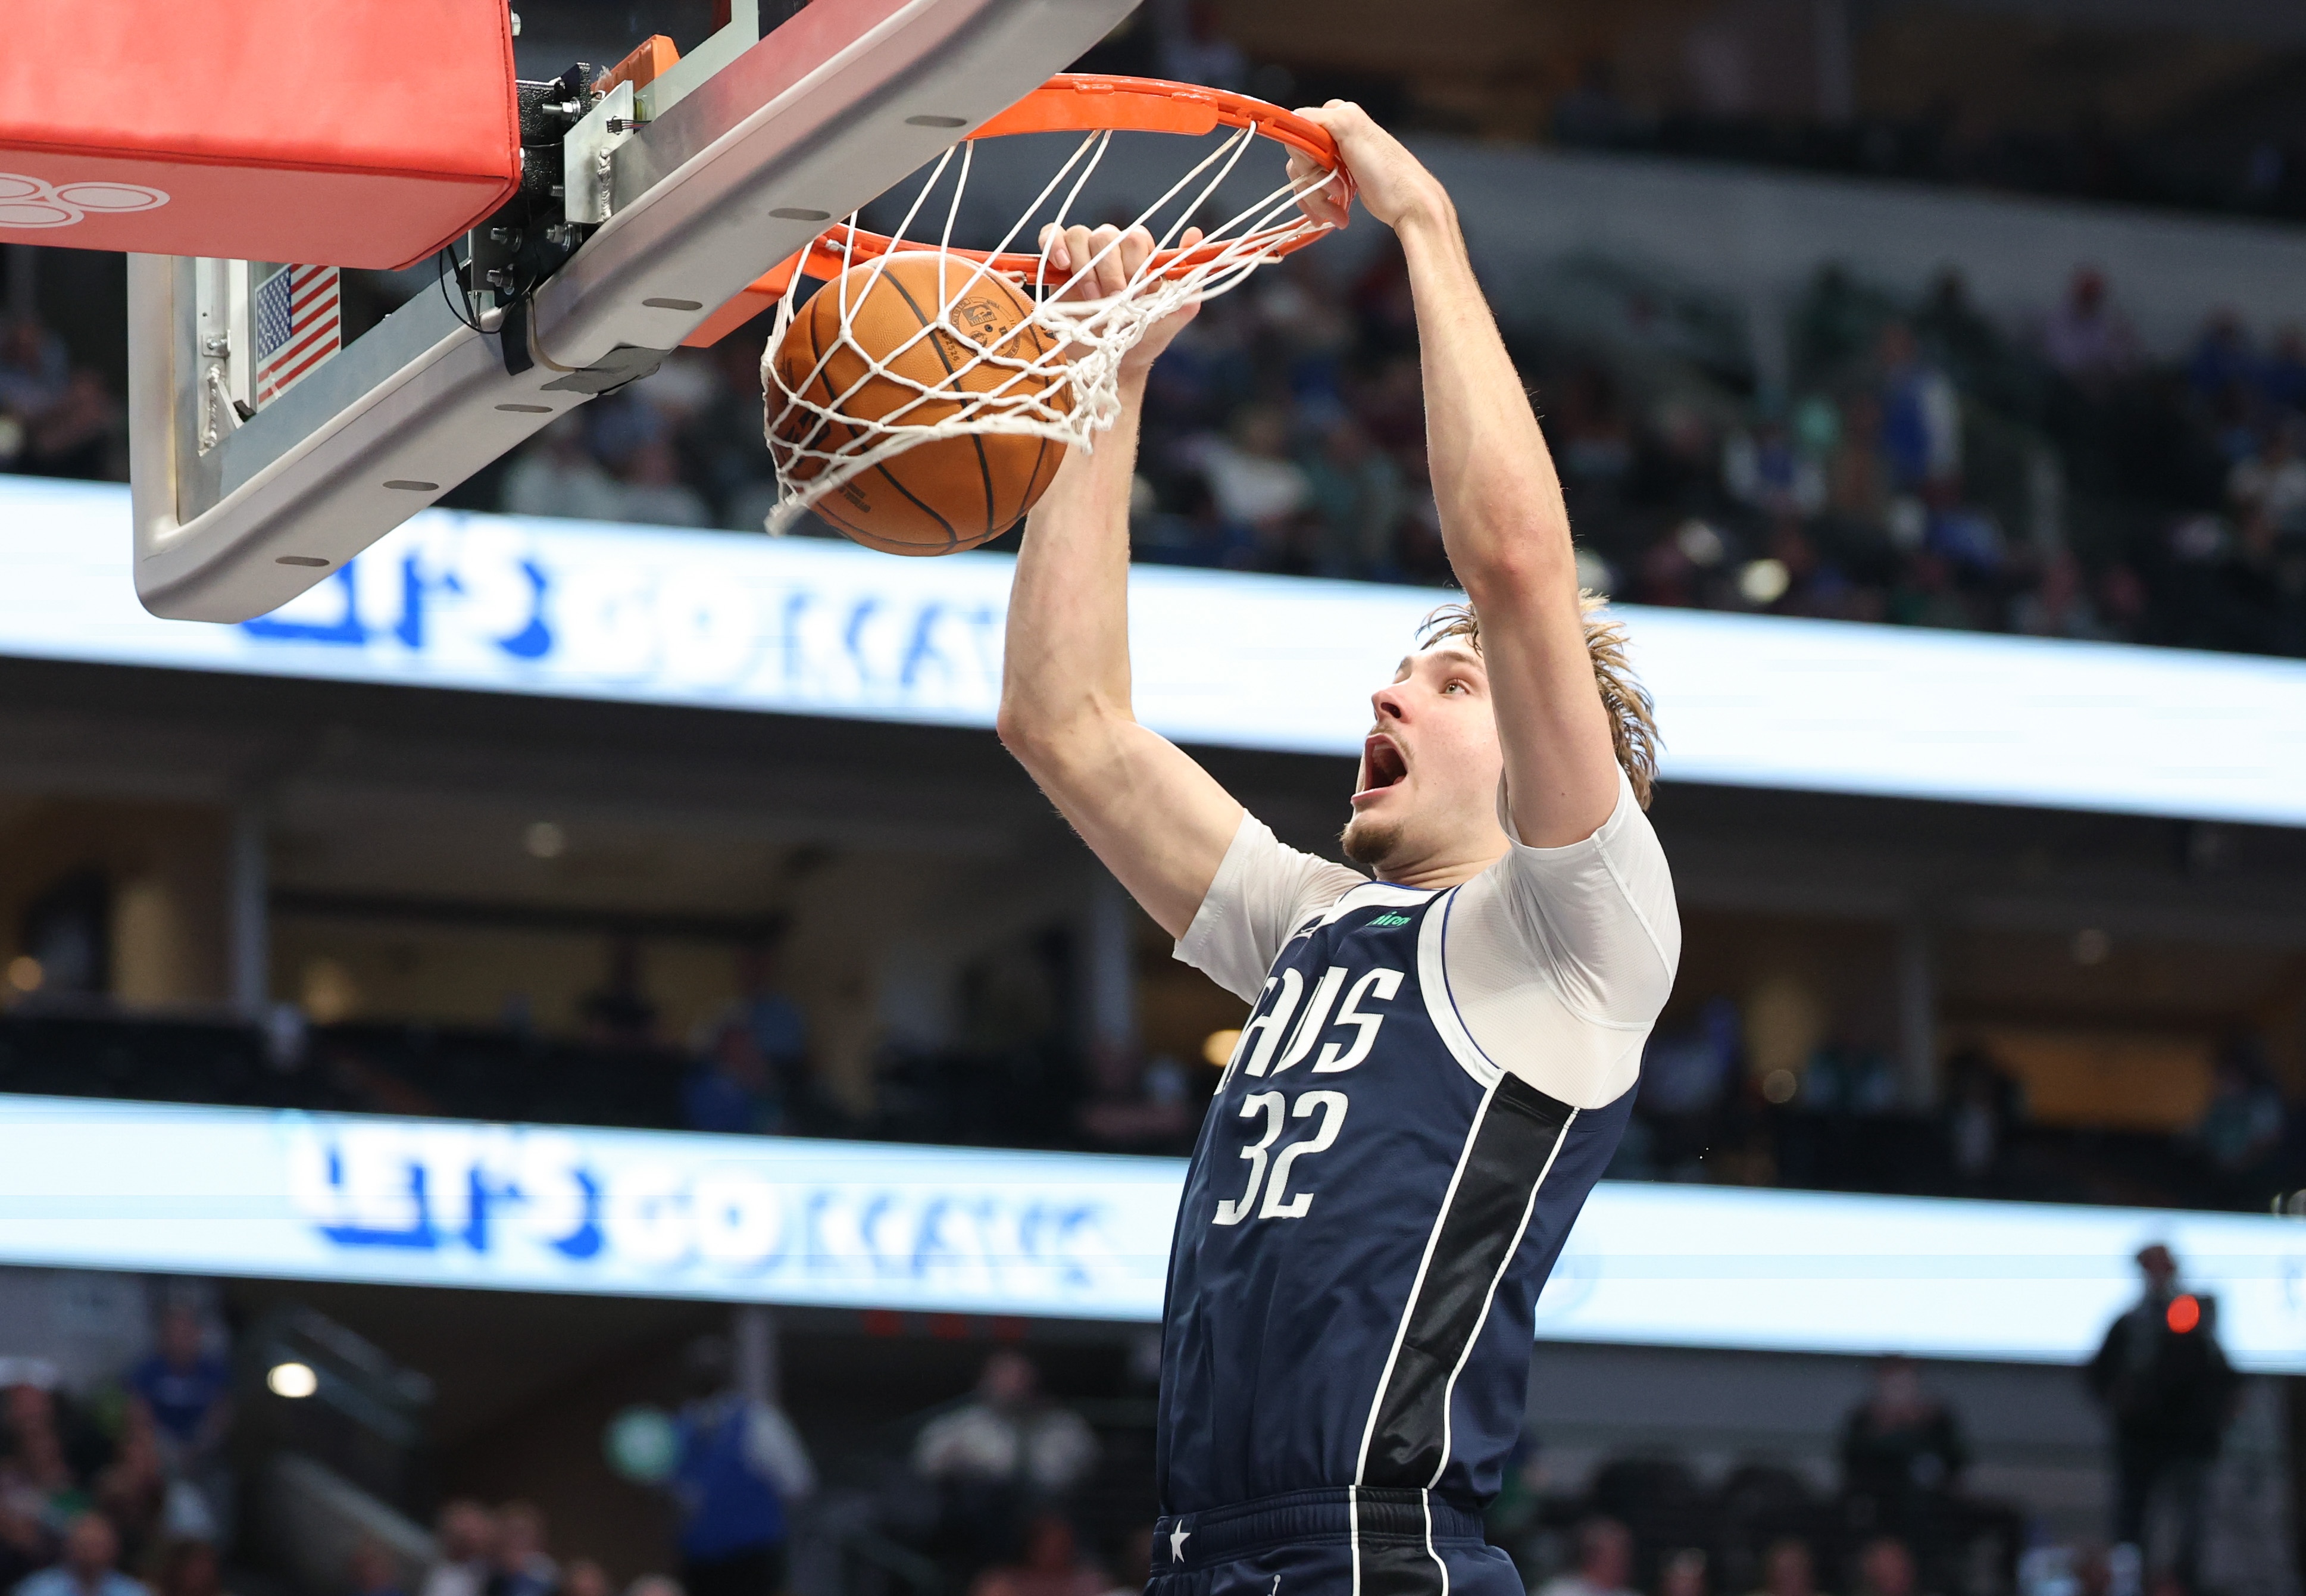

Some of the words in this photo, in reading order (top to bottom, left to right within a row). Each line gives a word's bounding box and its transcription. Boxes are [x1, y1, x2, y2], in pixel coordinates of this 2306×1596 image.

[1214, 966, 1405, 1095] AVS
[286, 1124, 607, 1266] LET'S
[1212, 1091, 1348, 1225] 32
